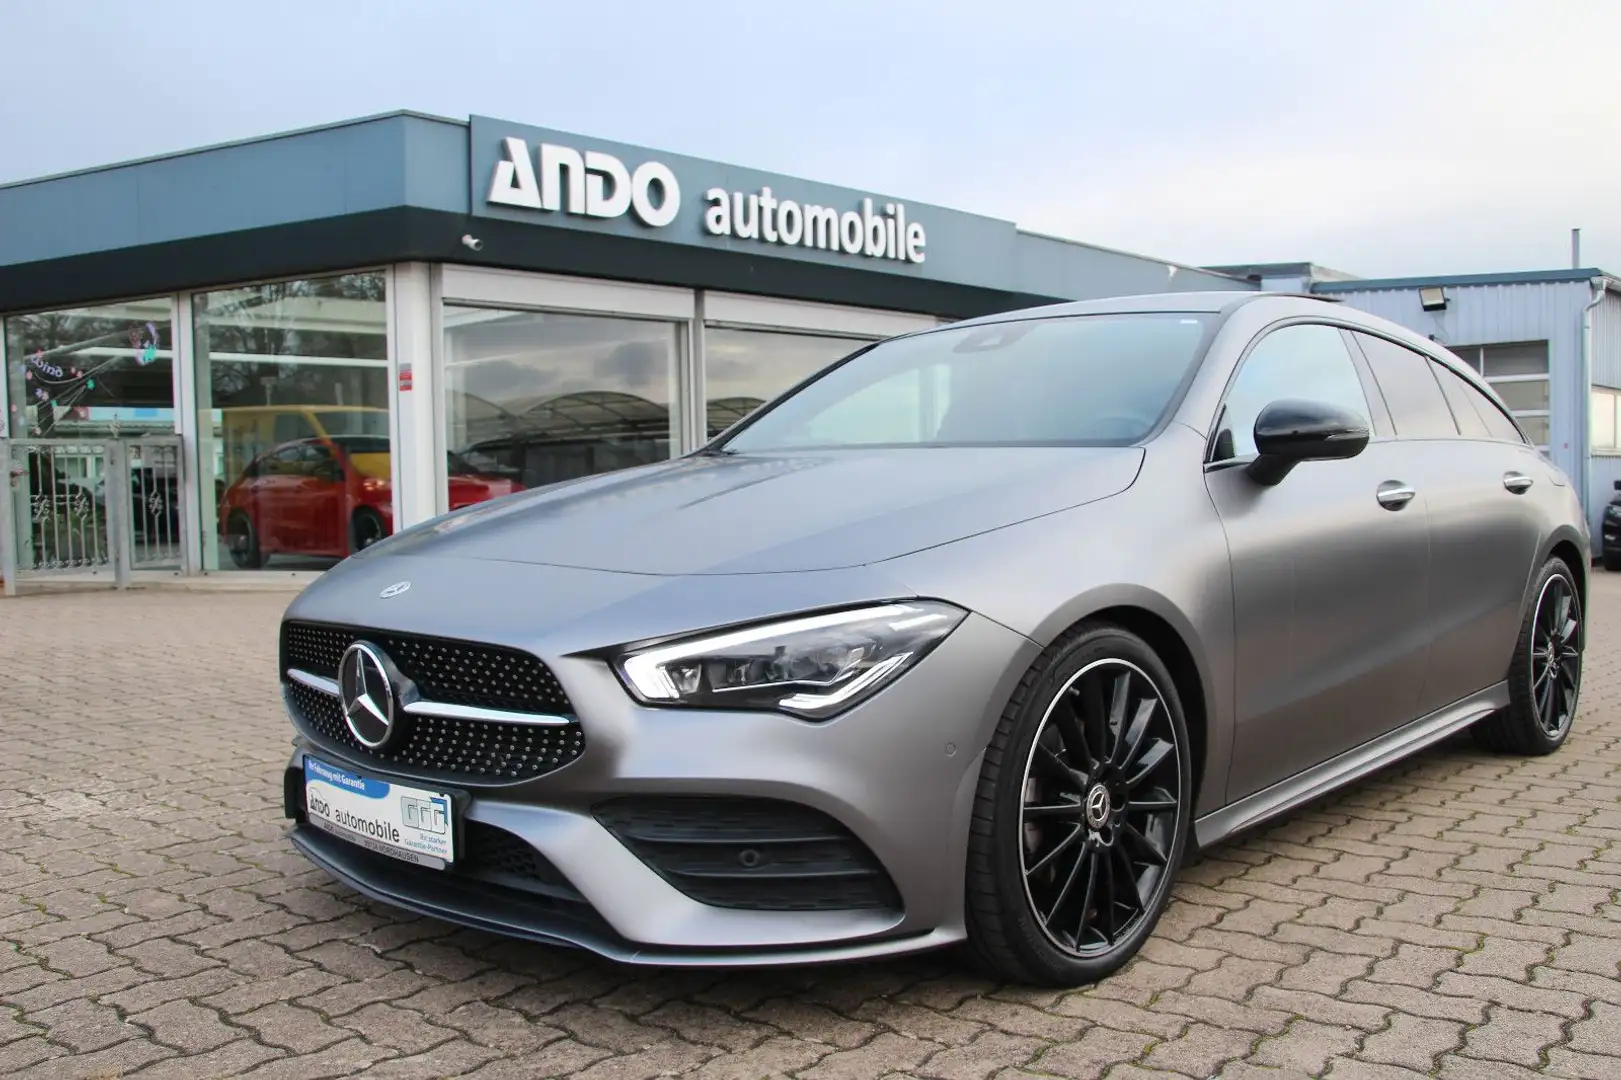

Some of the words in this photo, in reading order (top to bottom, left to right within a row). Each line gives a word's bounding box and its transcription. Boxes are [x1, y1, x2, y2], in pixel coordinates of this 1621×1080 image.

[487, 137, 680, 228] ANDO
[704, 187, 926, 264] automobile
[341, 774, 365, 791] Garantie
[335, 810, 400, 843] automobile
